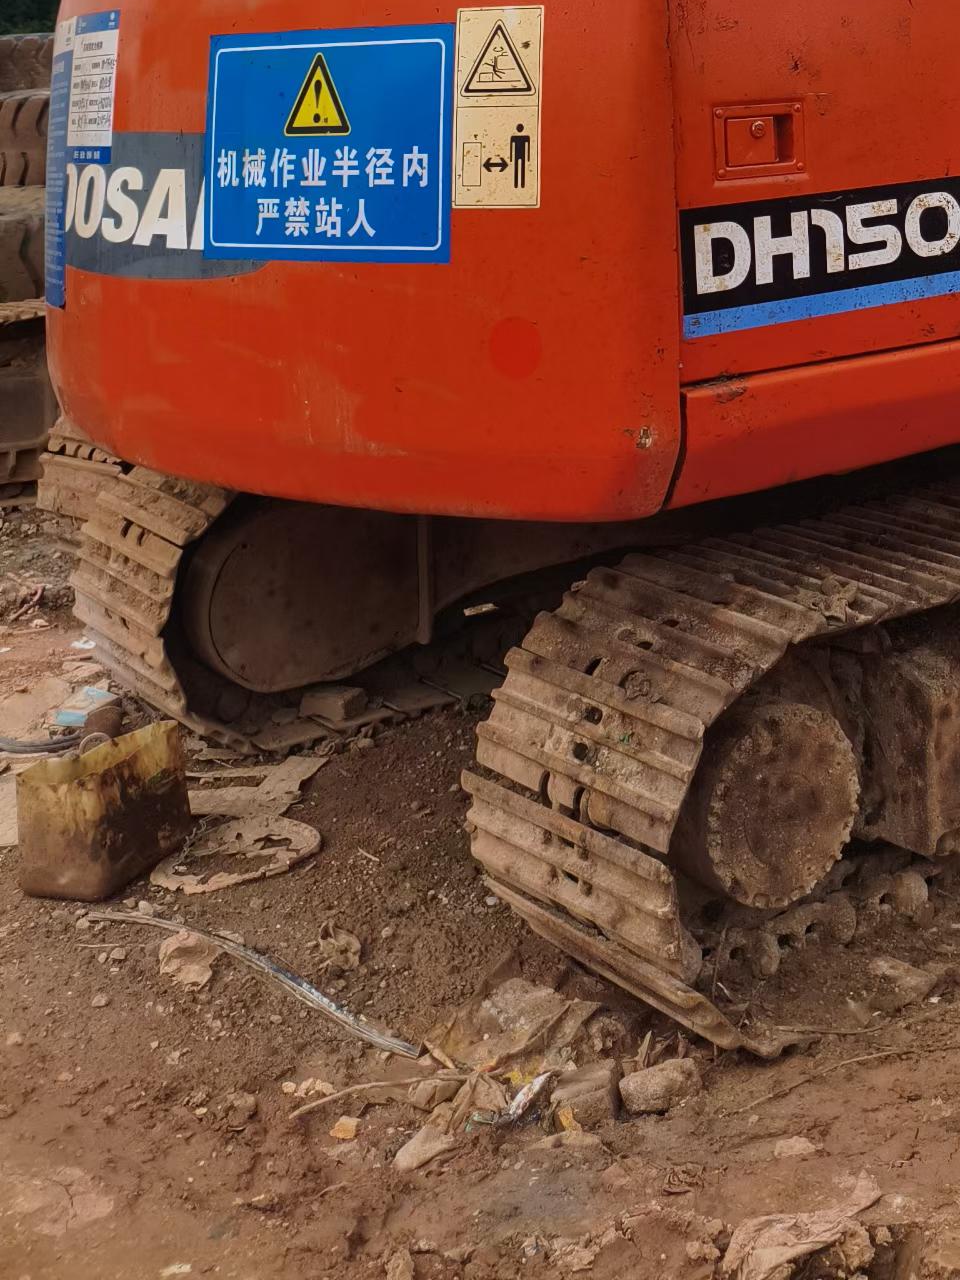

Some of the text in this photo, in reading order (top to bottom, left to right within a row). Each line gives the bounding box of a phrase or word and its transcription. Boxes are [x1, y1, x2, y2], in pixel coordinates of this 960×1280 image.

[217, 147, 430, 188] 机械作业半径内
[66, 163, 204, 250] OSA
[255, 198, 377, 238] 严禁站人
